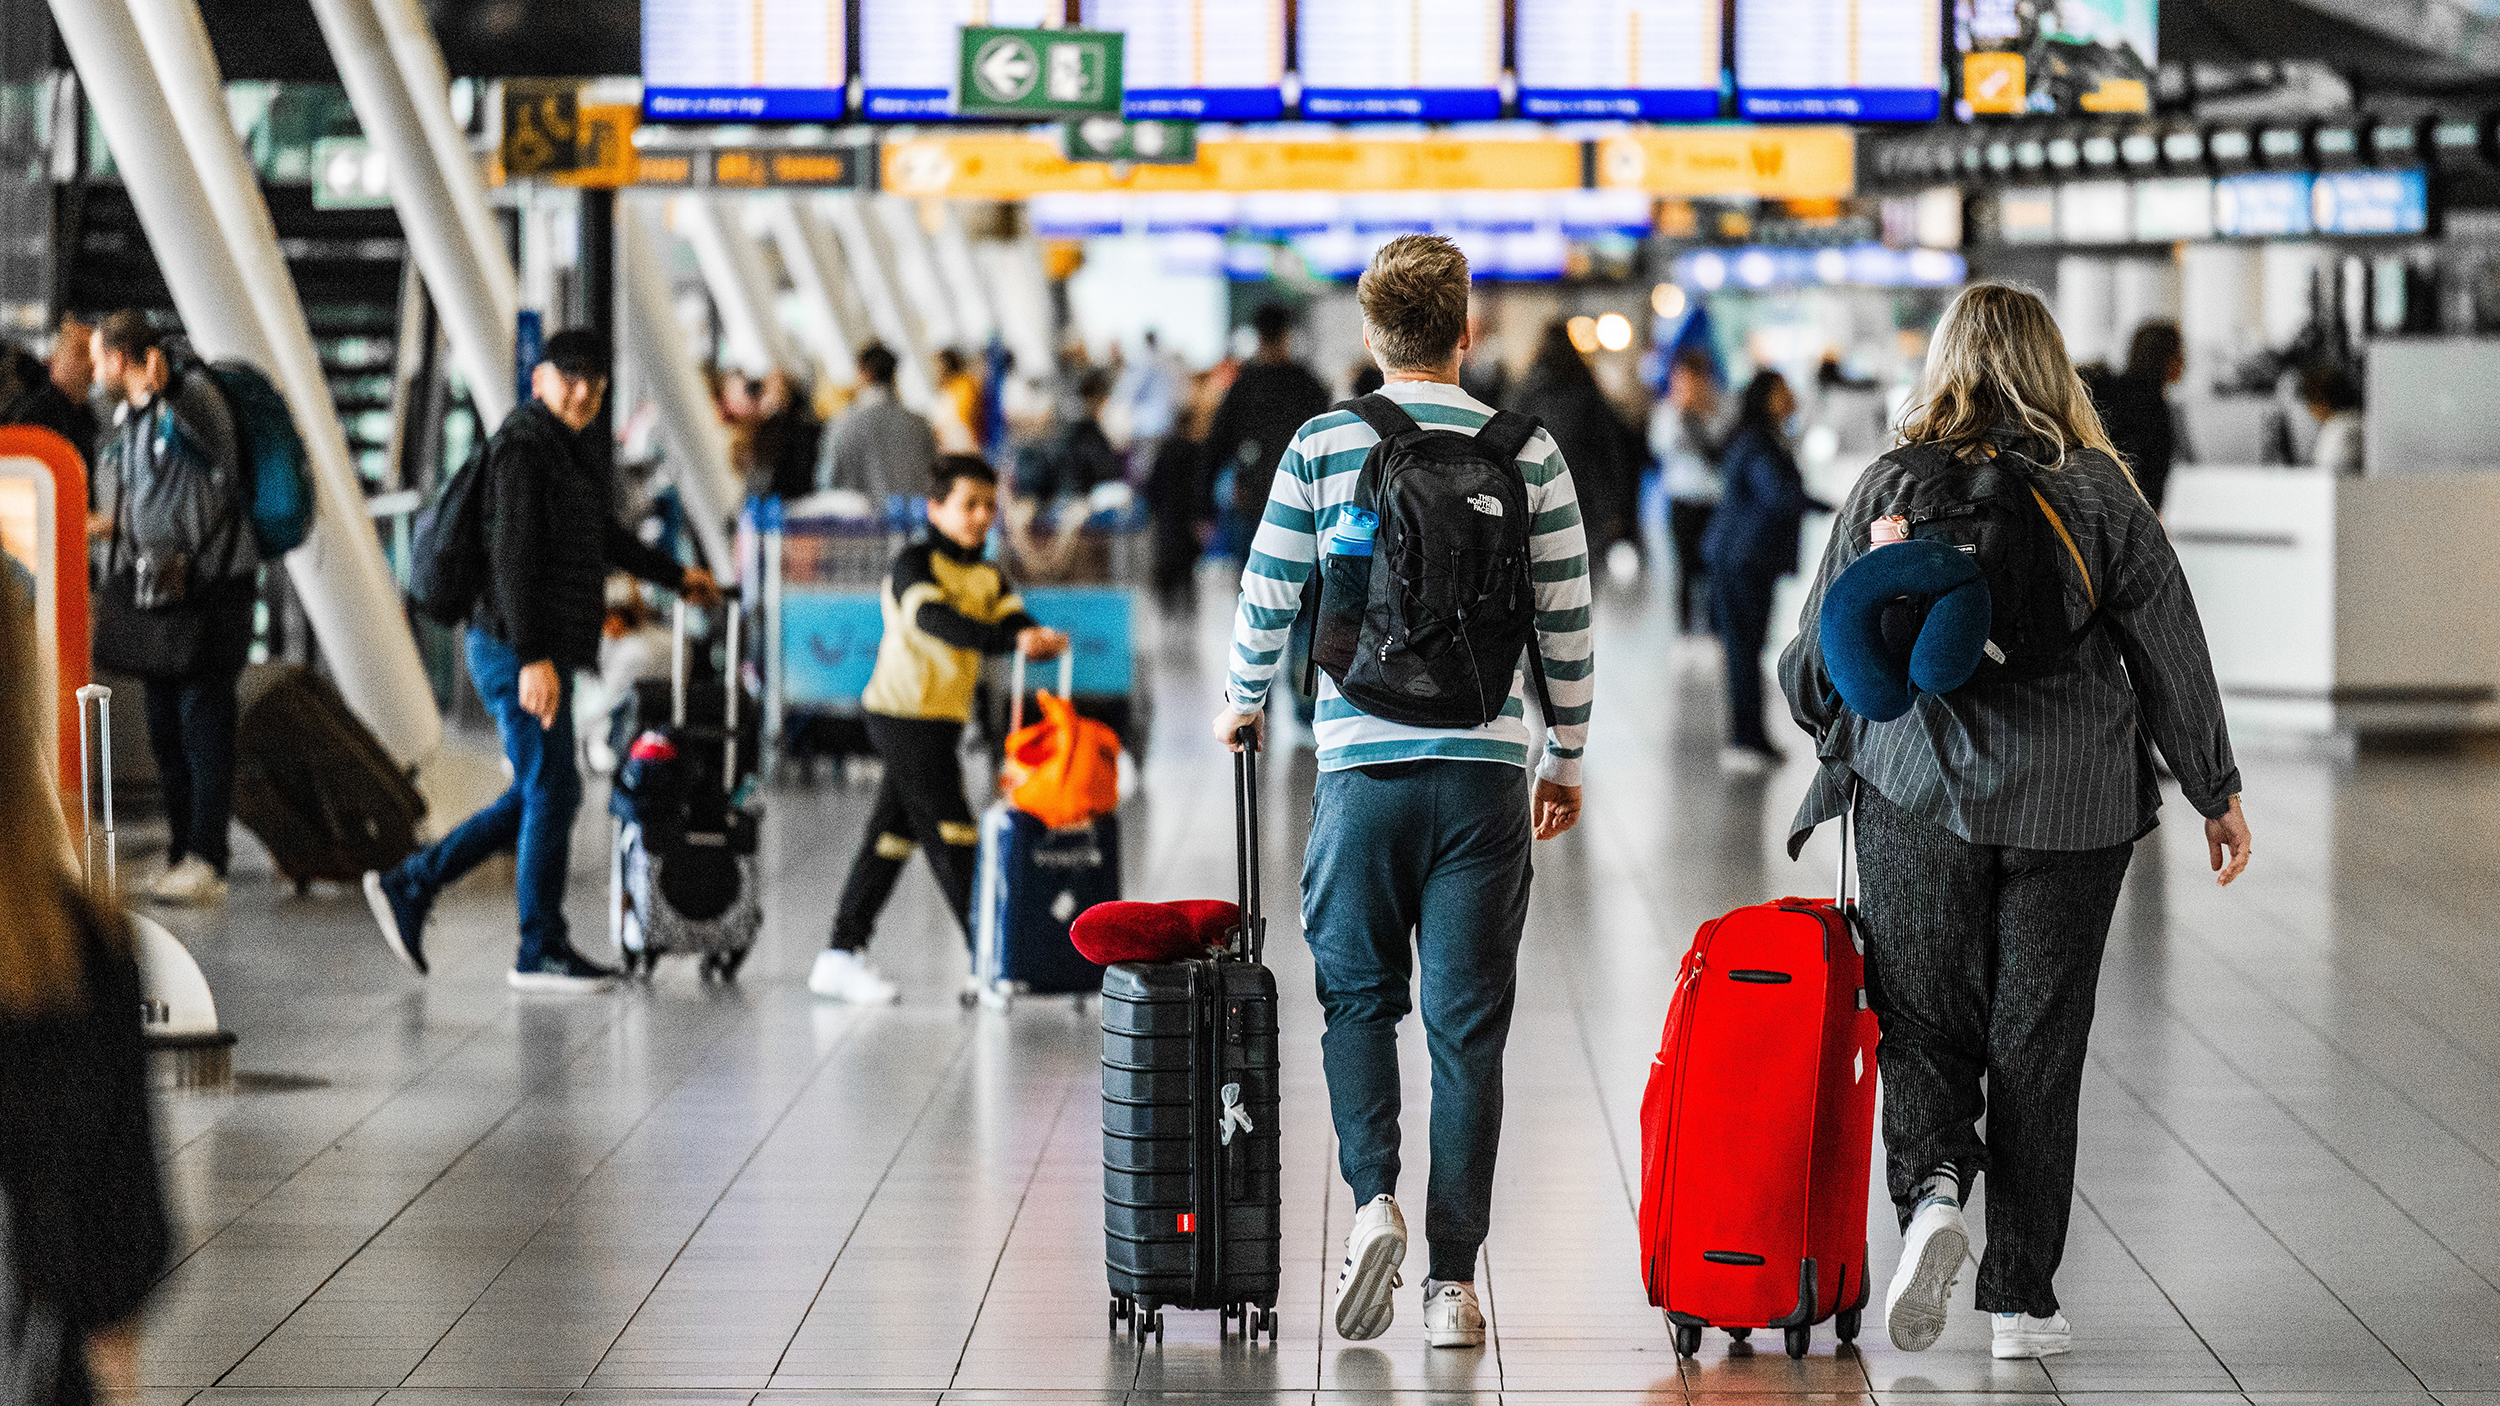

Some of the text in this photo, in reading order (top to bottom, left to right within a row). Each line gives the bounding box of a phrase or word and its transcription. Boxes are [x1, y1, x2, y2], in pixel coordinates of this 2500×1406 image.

[1467, 497, 1491, 508] NORTH
[1478, 493, 1492, 502] THE
[1474, 504, 1491, 515] FACE
